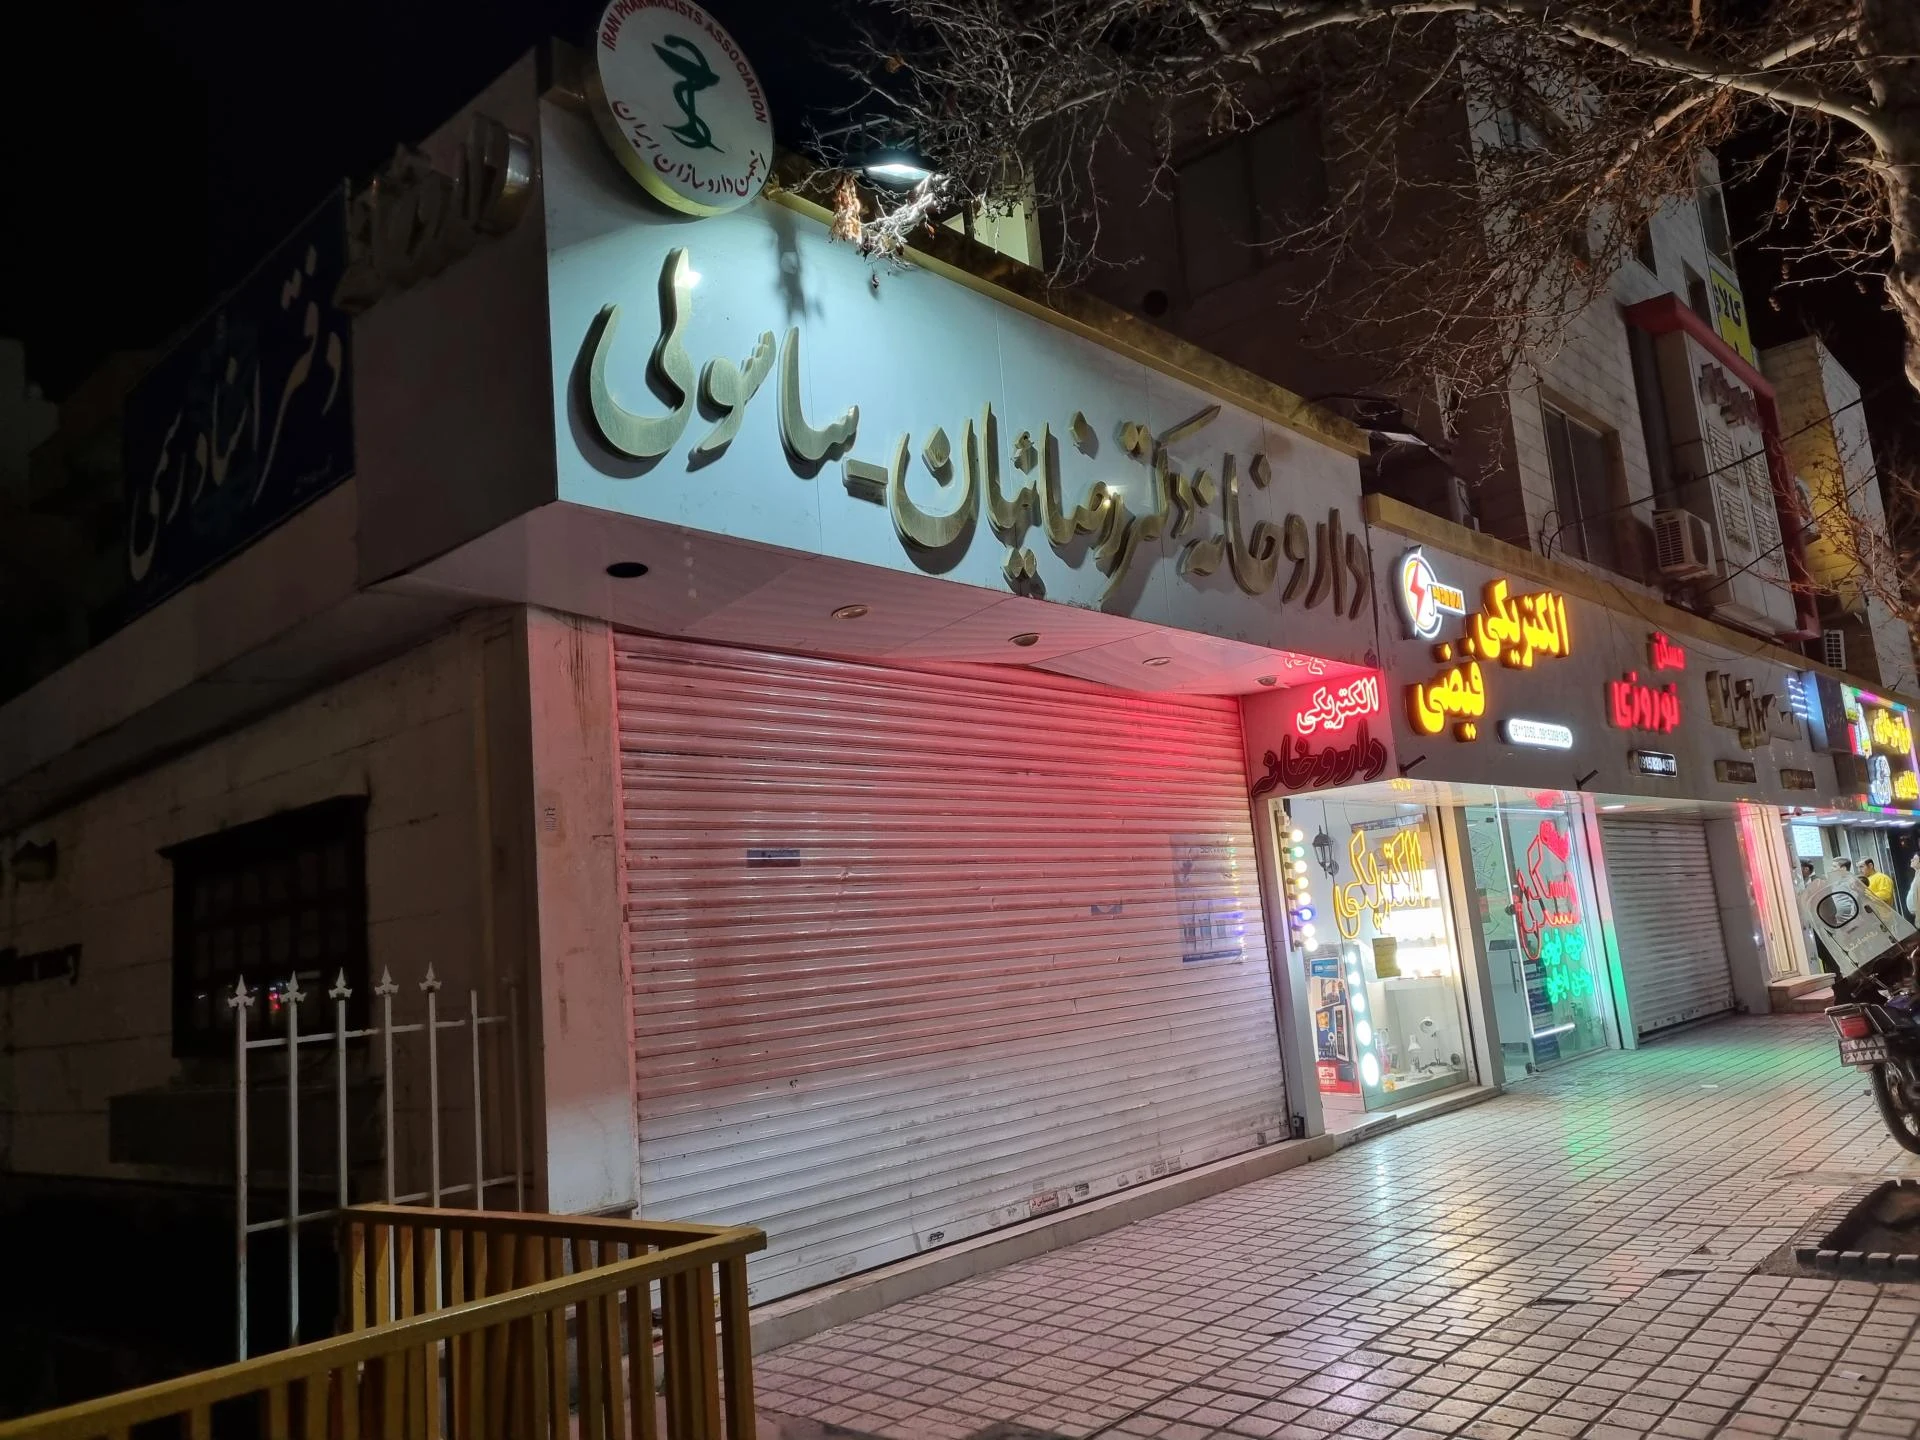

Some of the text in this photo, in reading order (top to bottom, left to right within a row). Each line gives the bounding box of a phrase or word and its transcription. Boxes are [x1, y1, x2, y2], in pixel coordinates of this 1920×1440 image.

[601, 12, 621, 51] IRAN
[702, 22, 767, 124] ASSOCIATION
[612, 100, 660, 149] ایران
[734, 150, 767, 196] انجمن
[1477, 579, 1570, 667] الکتریکی
[1297, 676, 1379, 734] الکتریکی
[1417, 637, 1486, 740] فیضی
[1611, 671, 1681, 734] نوروزی
[1251, 718, 1387, 797] داروخانه
[1333, 830, 1425, 939] الکتریکی
